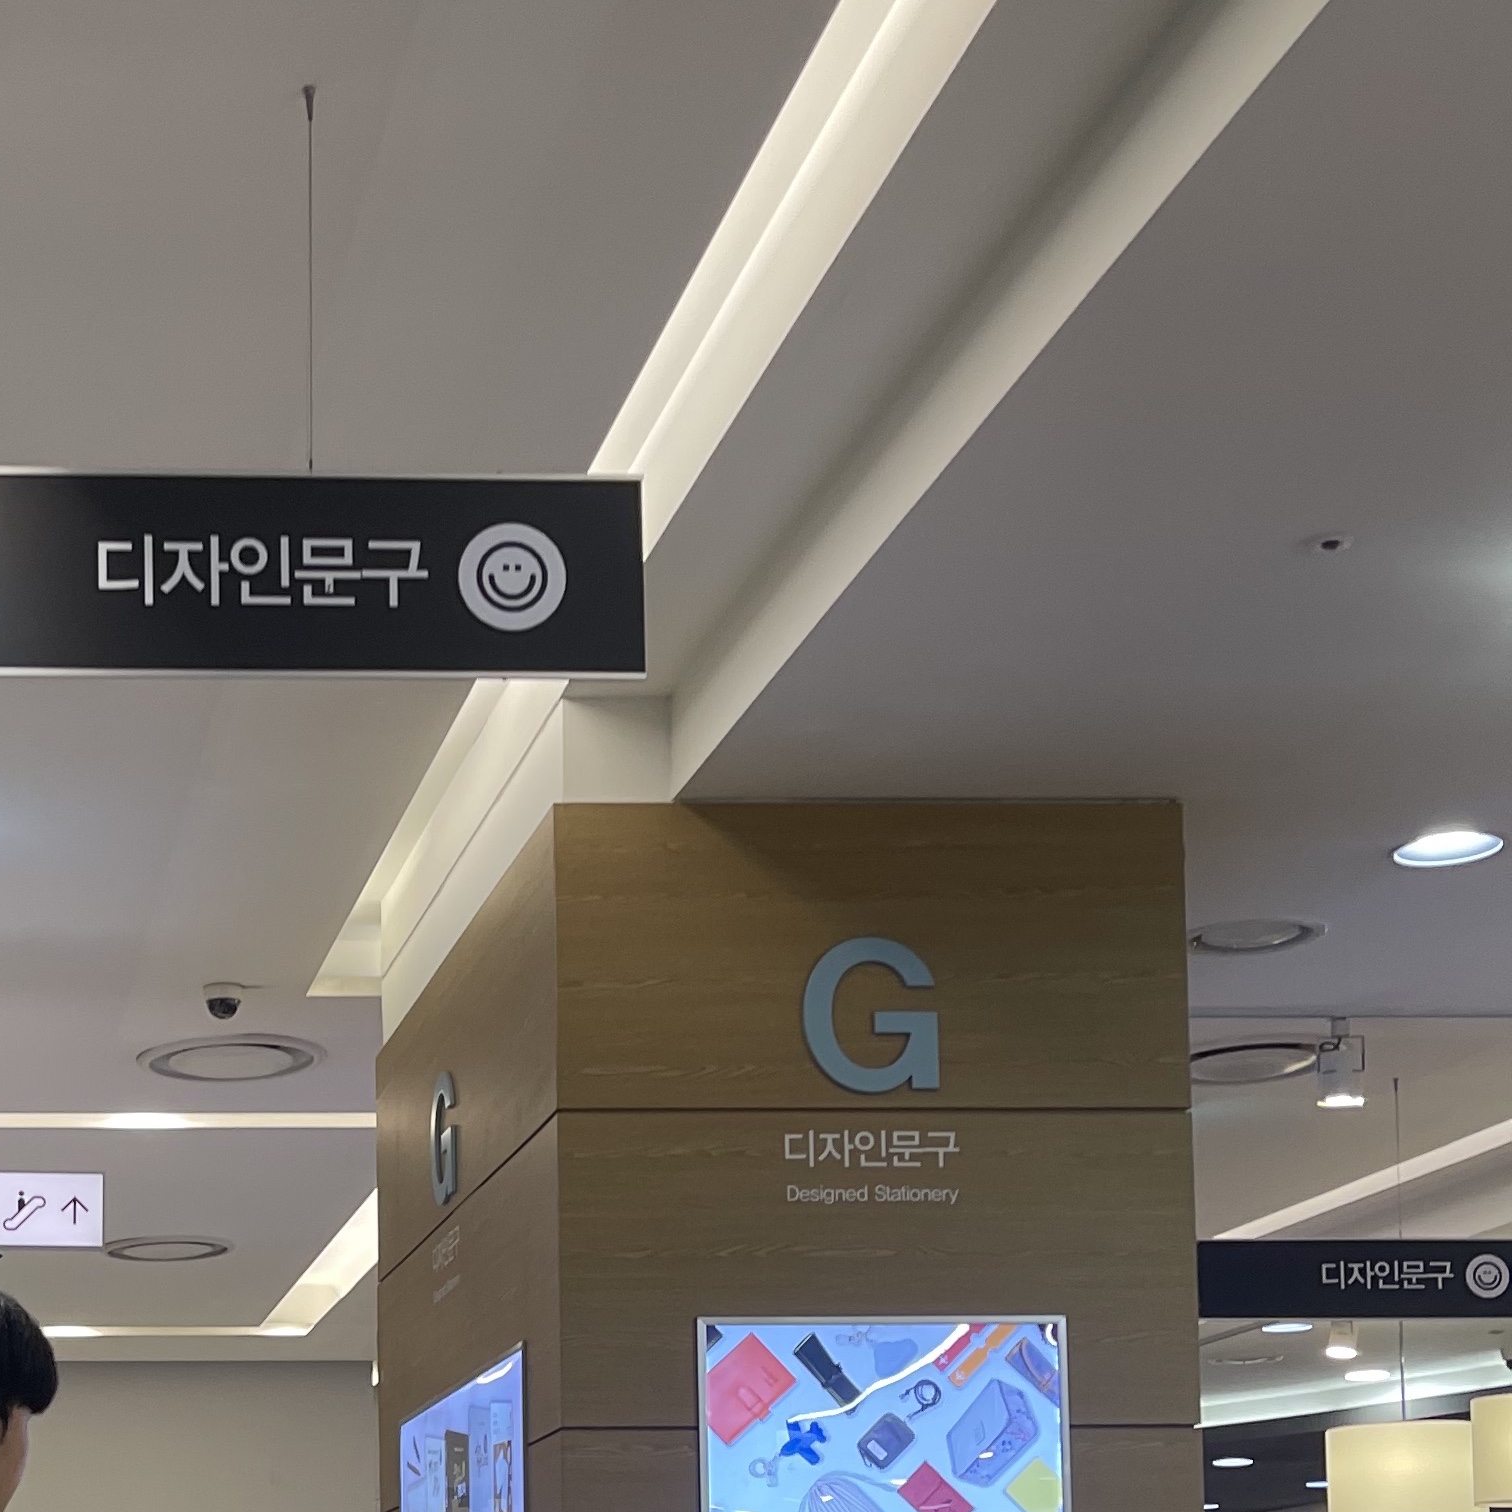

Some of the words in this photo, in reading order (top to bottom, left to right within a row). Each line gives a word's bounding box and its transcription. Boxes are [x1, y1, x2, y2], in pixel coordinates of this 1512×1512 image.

[97, 533, 429, 608] 디자인문구
[803, 936, 940, 1094] G
[430, 1071, 458, 1206] G
[784, 1129, 960, 1168] 디자인문구
[787, 1184, 868, 1205] Designed
[874, 1184, 960, 1205] Stationery
[1321, 1260, 1455, 1290] 디자인문구
